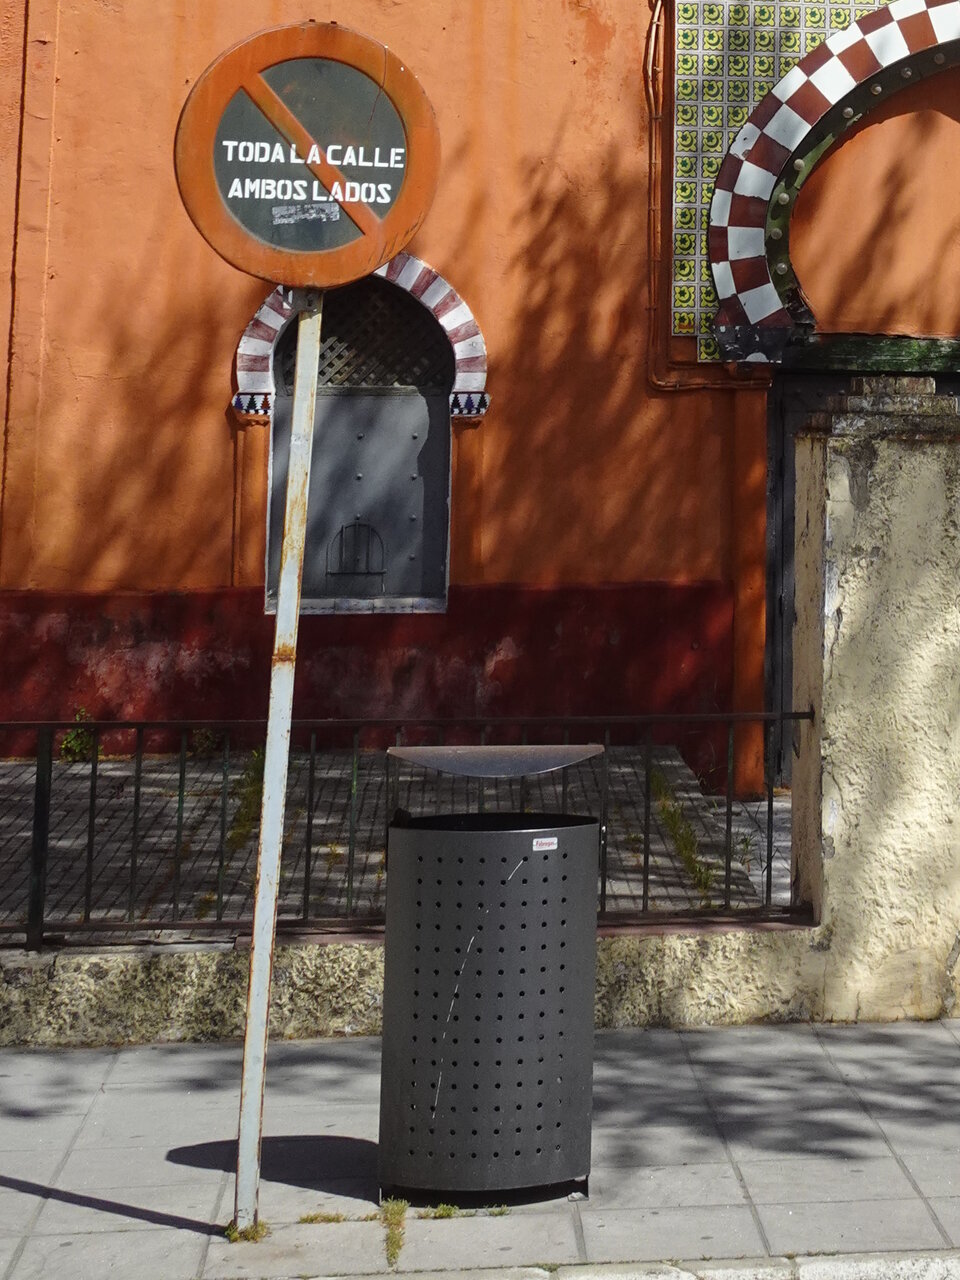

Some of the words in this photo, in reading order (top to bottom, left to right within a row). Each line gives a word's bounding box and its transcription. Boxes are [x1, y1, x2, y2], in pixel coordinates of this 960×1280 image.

[222, 140, 285, 164] TODA
[290, 144, 321, 165] LA
[326, 145, 405, 169] CALLE
[227, 178, 308, 201] AMBOS
[312, 180, 391, 204] LADOS
